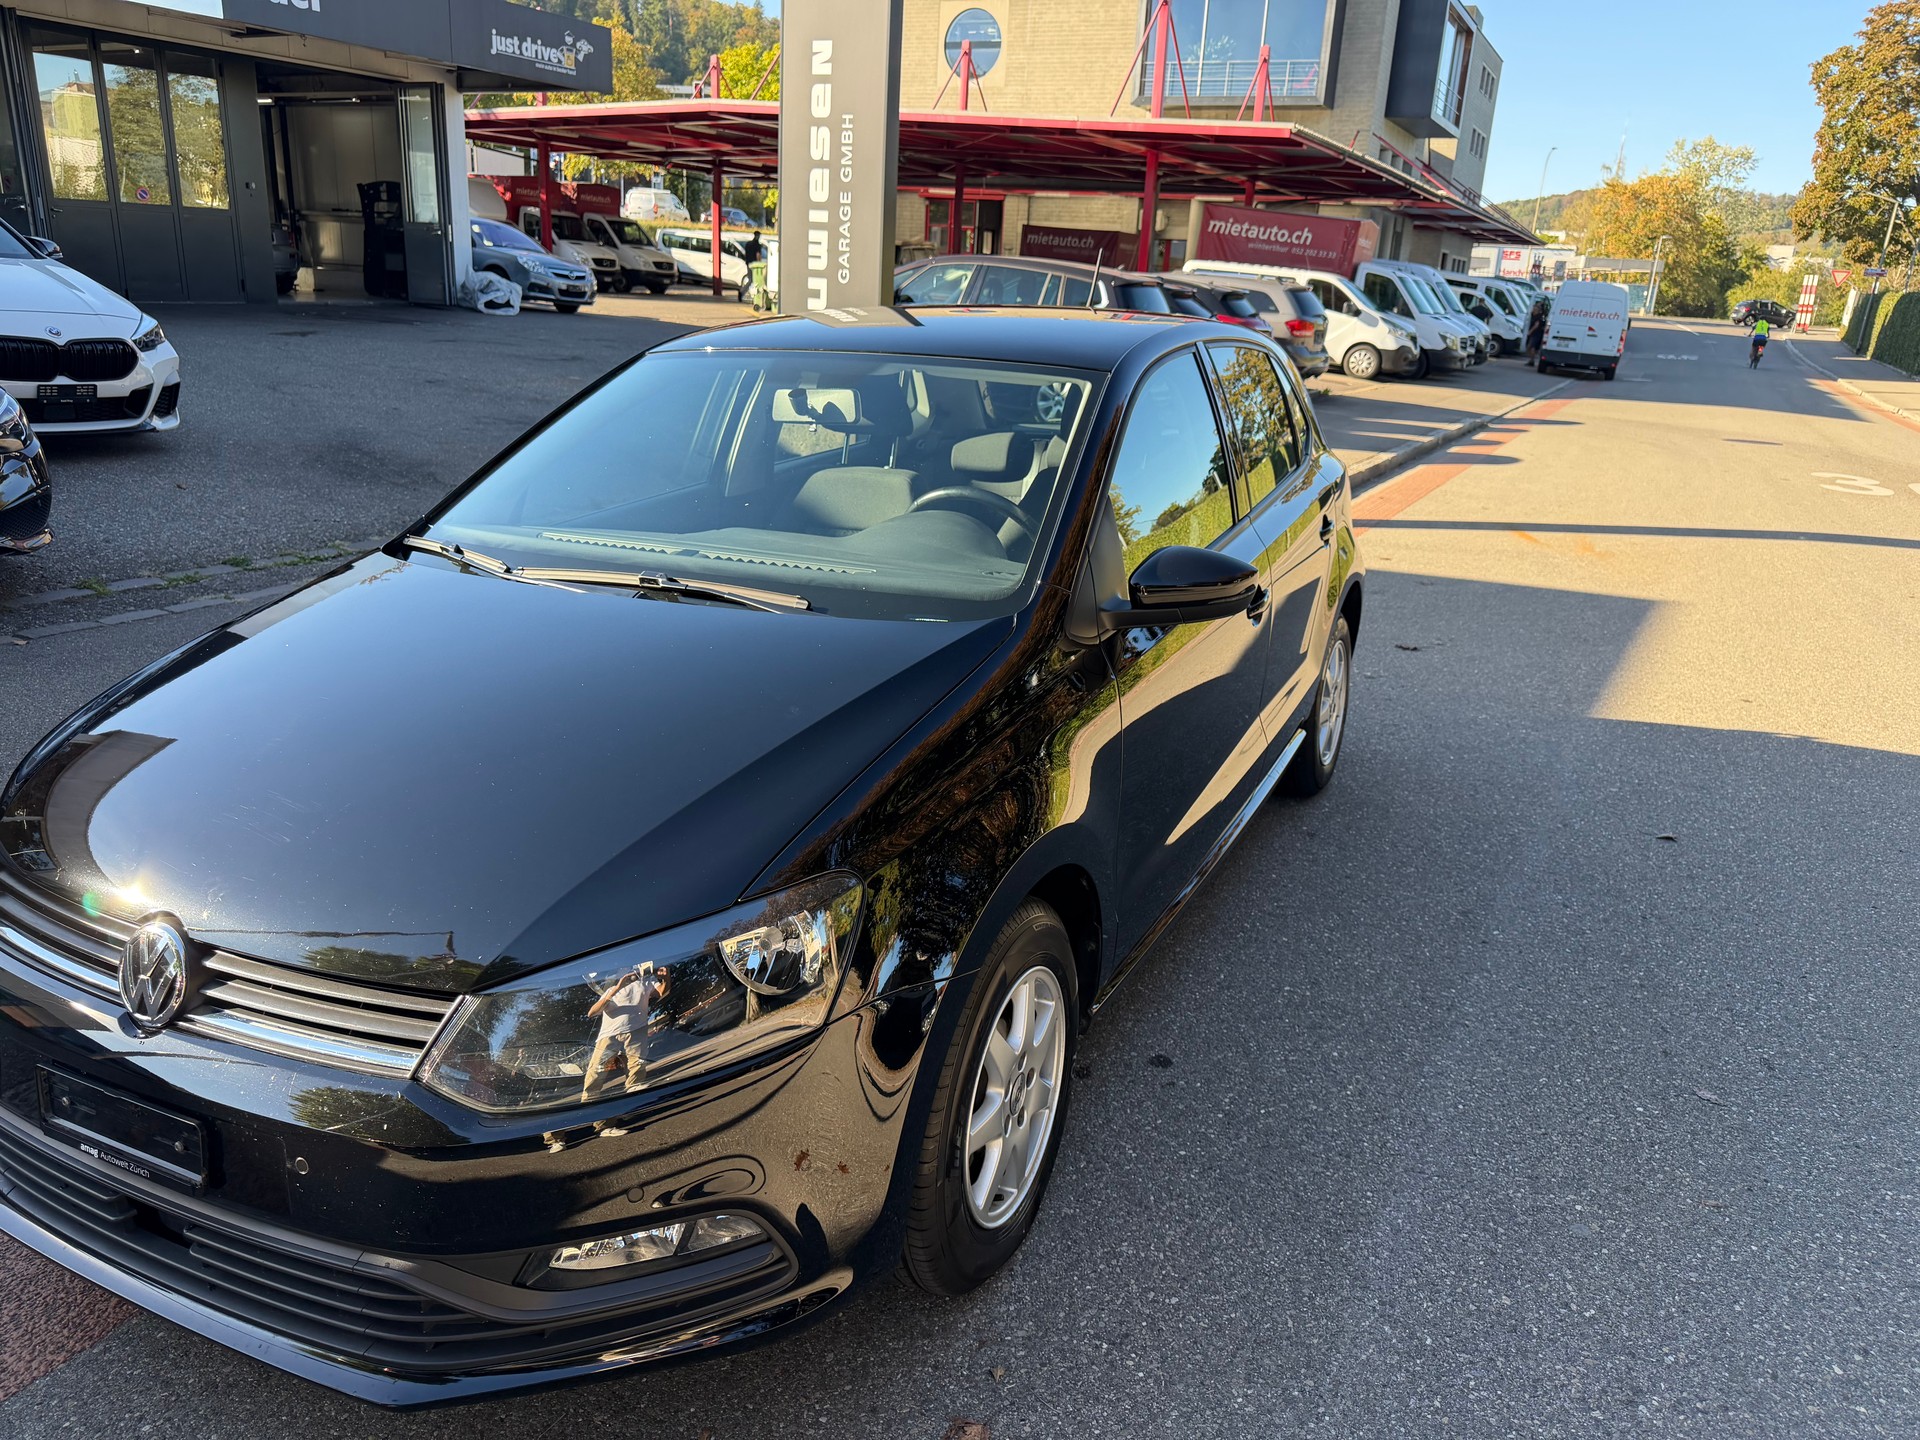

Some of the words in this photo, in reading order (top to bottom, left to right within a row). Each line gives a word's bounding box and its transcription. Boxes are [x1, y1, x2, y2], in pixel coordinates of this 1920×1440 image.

[490, 28, 520, 55] just
[521, 36, 559, 63] drive
[840, 113, 854, 182] GMBH
[807, 39, 833, 310] uwiesen
[838, 191, 852, 284] GARAGE
[1026, 232, 1095, 249] mietauto.ch
[1207, 218, 1313, 246] mietauto.ch
[1559, 307, 1620, 321] mietauto.ch
[1810, 472, 1920, 497] 3
[80, 1143, 99, 1159] amag
[100, 1151, 129, 1170] Autowelt
[129, 1162, 150, 1178] Zürich
